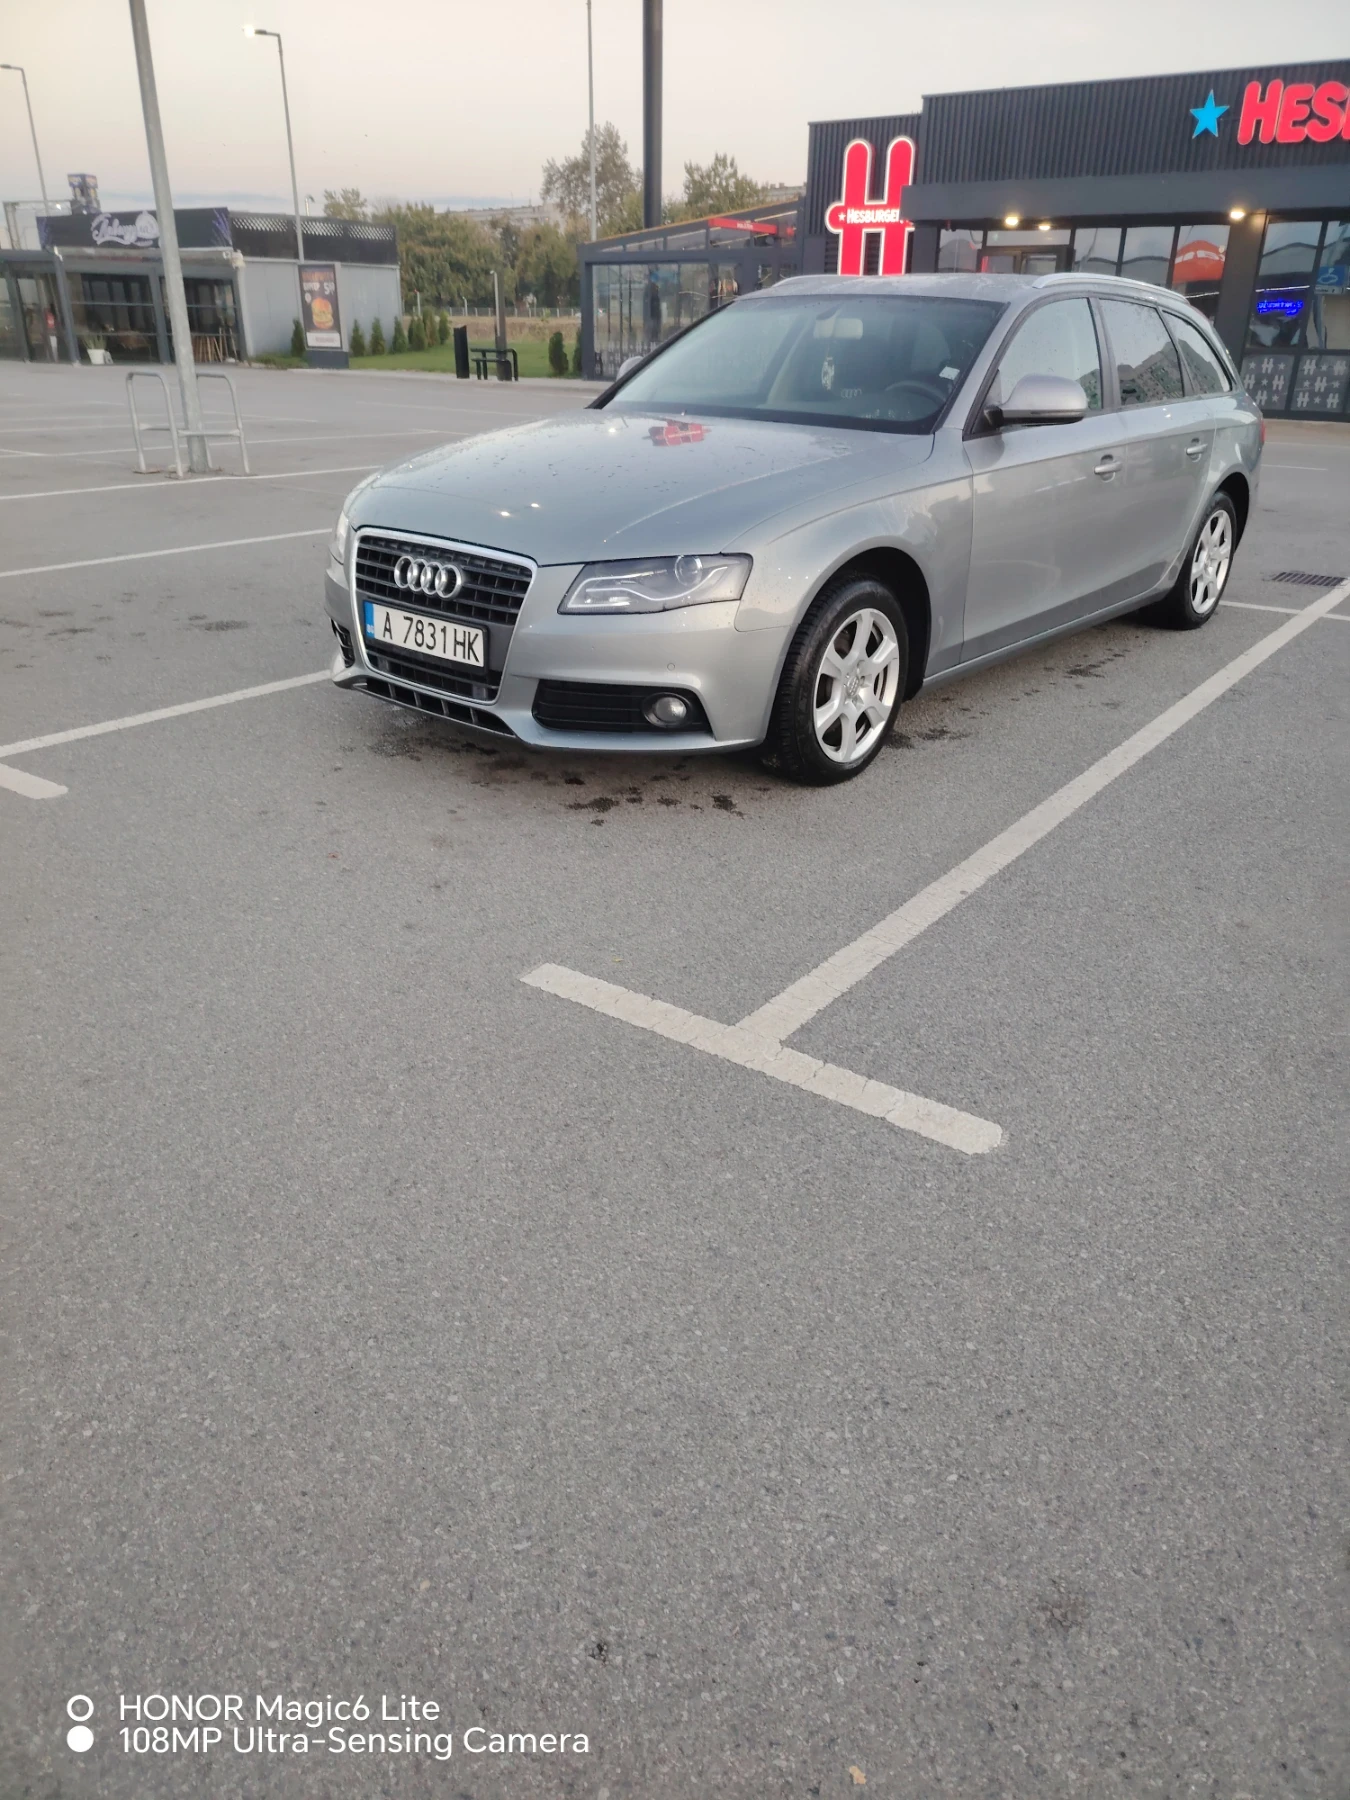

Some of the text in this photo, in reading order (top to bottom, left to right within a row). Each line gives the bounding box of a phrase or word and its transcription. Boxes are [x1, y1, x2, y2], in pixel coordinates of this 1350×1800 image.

[1237, 78, 1350, 146] HES
[382, 611, 480, 663] A 7831 HK
